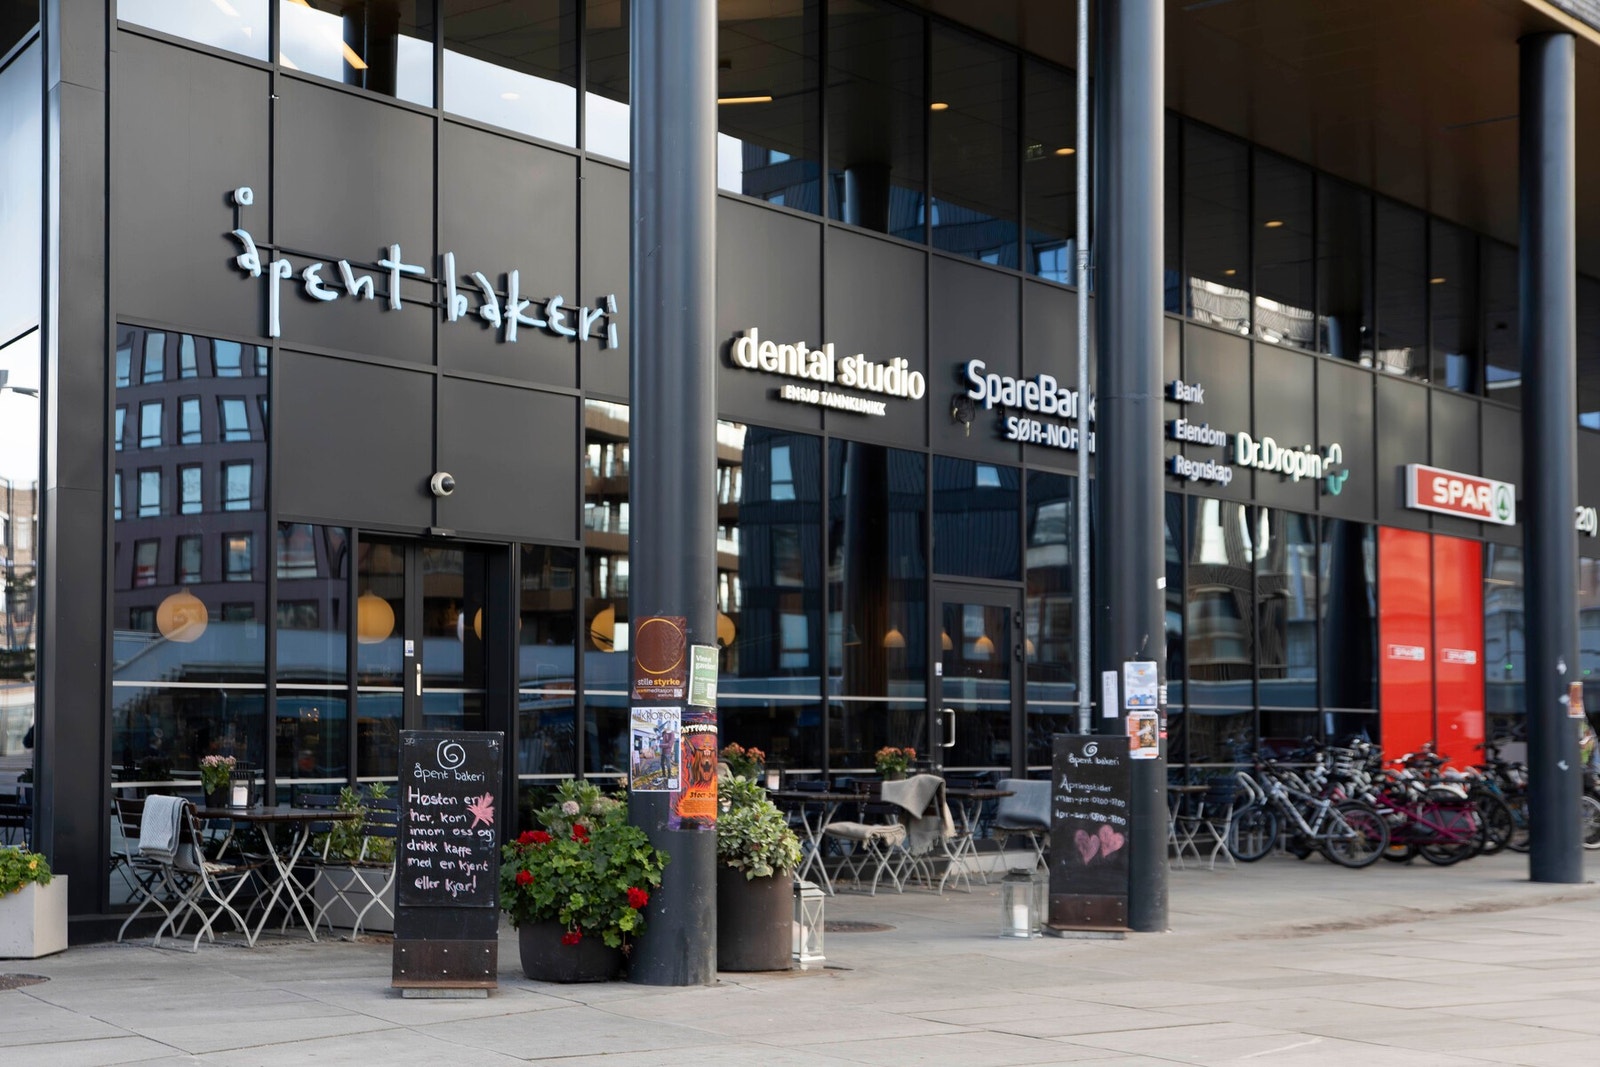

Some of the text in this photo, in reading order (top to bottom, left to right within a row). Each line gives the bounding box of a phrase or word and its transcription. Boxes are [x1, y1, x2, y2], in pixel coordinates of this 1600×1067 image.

[232, 186, 619, 350] åpent bakeri
[731, 327, 926, 400] dental studio
[781, 384, 820, 404] ENSJØ
[1173, 380, 1205, 404] Bank
[1005, 415, 1096, 454] SØR-NOR
[1173, 418, 1227, 447] Eiendom
[1235, 431, 1323, 483] Dr.Dropin
[1172, 454, 1233, 487] Regnskap
[1432, 476, 1492, 513] SPAR
[637, 678, 681, 687] stille styrke
[413, 762, 485, 783] åpent bakeri
[407, 785, 458, 806] Høsten
[440, 812, 467, 823] kom
[409, 825, 493, 842] innom oss og
[406, 841, 472, 856] drikk kaffe
[407, 857, 489, 877] med en kjent
[414, 875, 440, 890] eller
